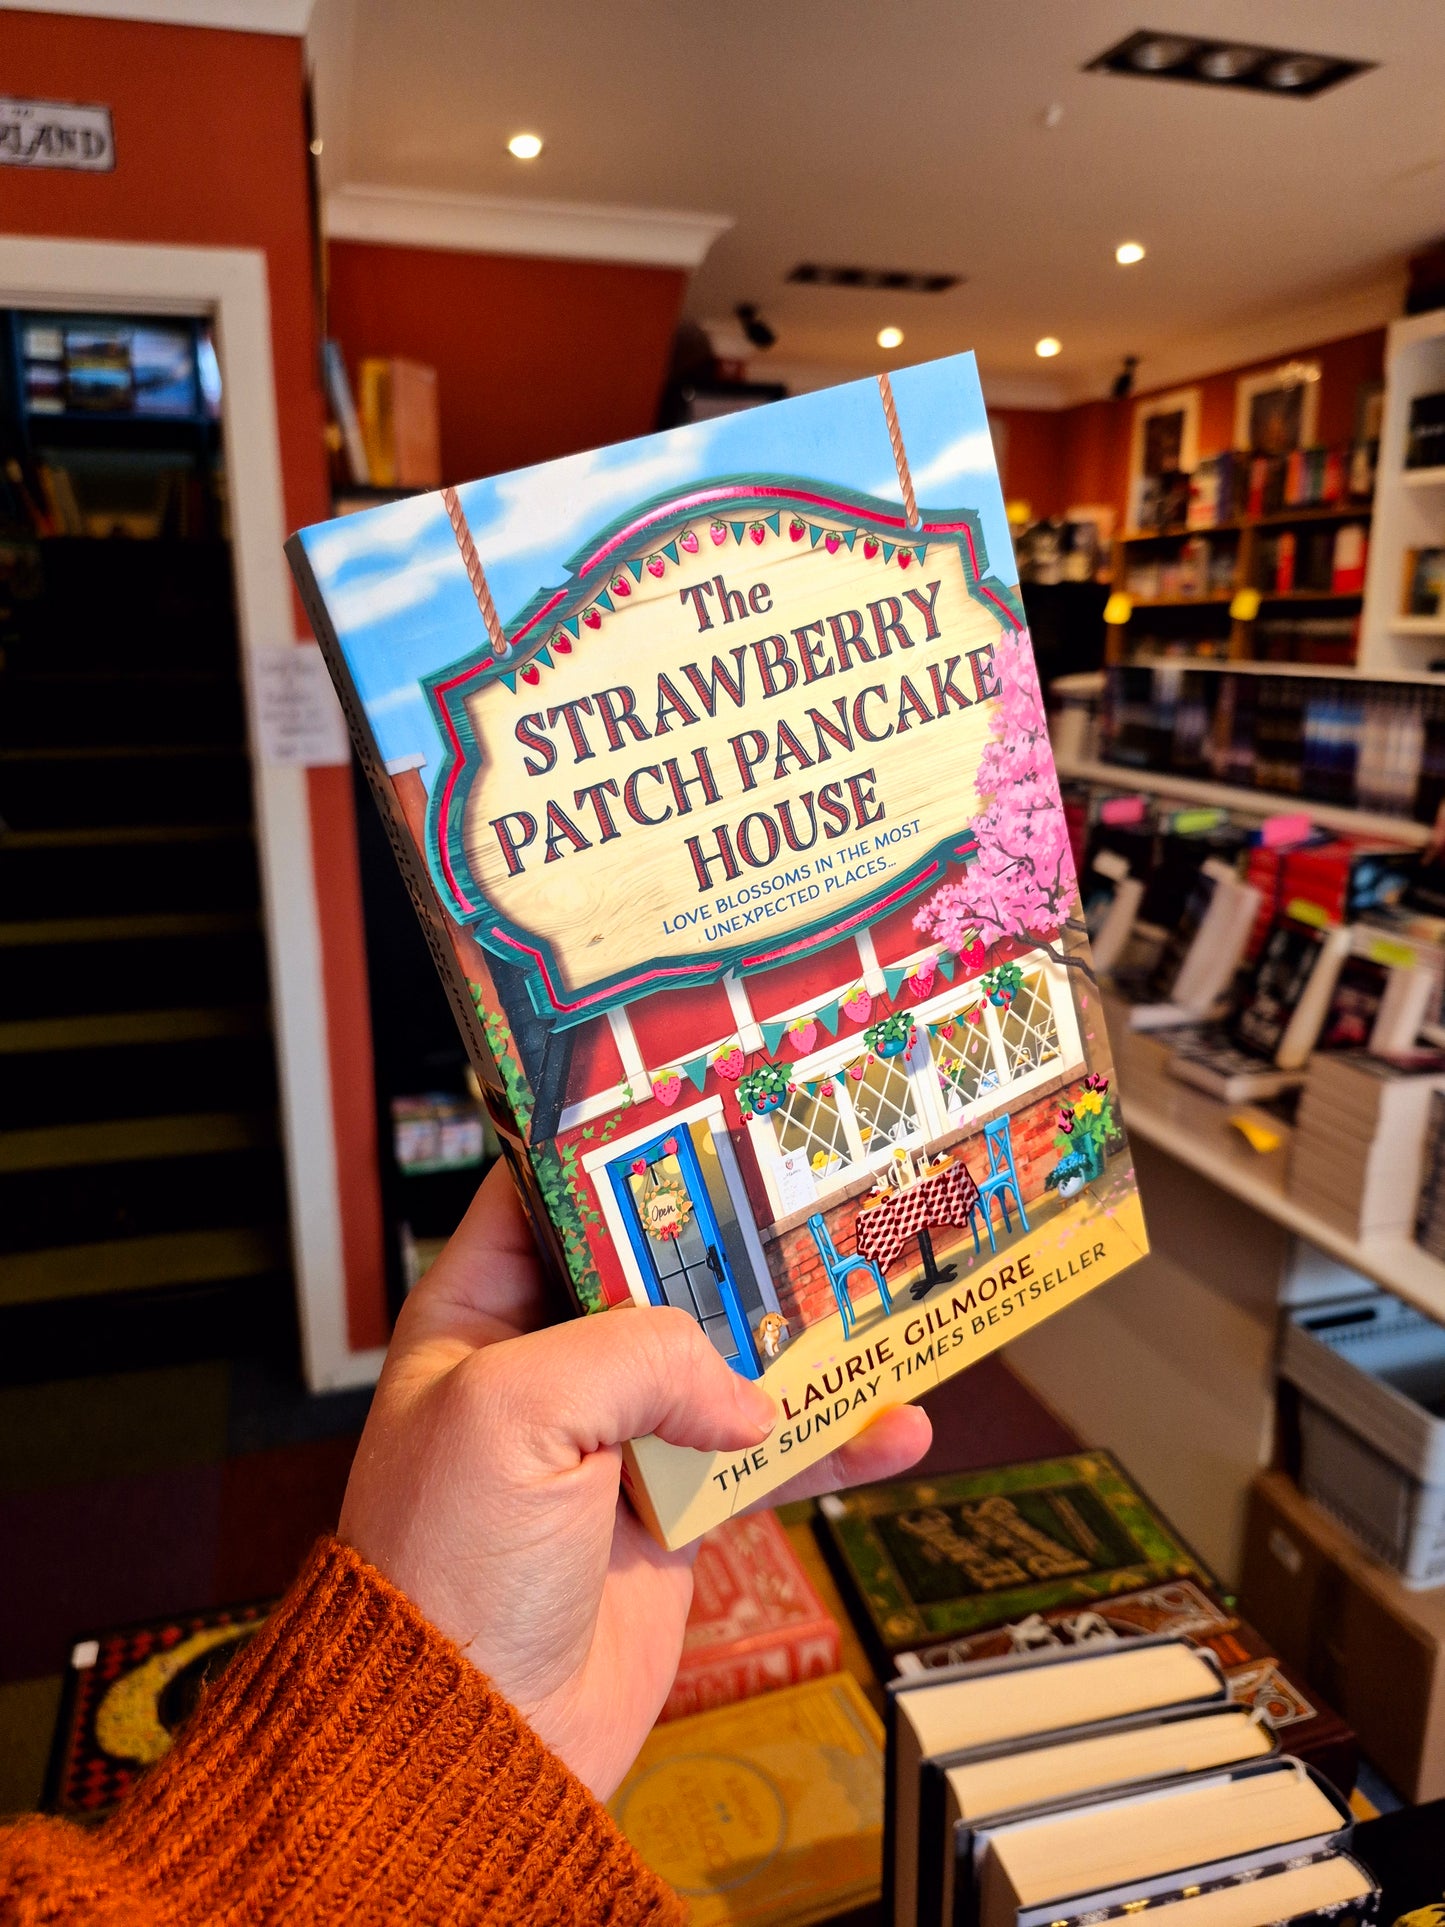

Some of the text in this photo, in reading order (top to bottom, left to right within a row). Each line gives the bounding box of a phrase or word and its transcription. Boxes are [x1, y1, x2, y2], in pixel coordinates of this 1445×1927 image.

[681, 574, 773, 633] The
[515, 580, 941, 776] STRAWBERRY
[489, 643, 1003, 877] PATCH PANCAKE
[662, 819, 921, 935] LOVE BLOSSOMS IN THE MOST
[684, 768, 886, 893] HOUSE
[703, 886, 820, 942] UNEXPECTED
[652, 1204, 675, 1221] Open
[713, 1242, 1108, 1492] THE SUNDAY TIMES BESTSELLER
[781, 1254, 1035, 1421] LAURIE GILMORE
